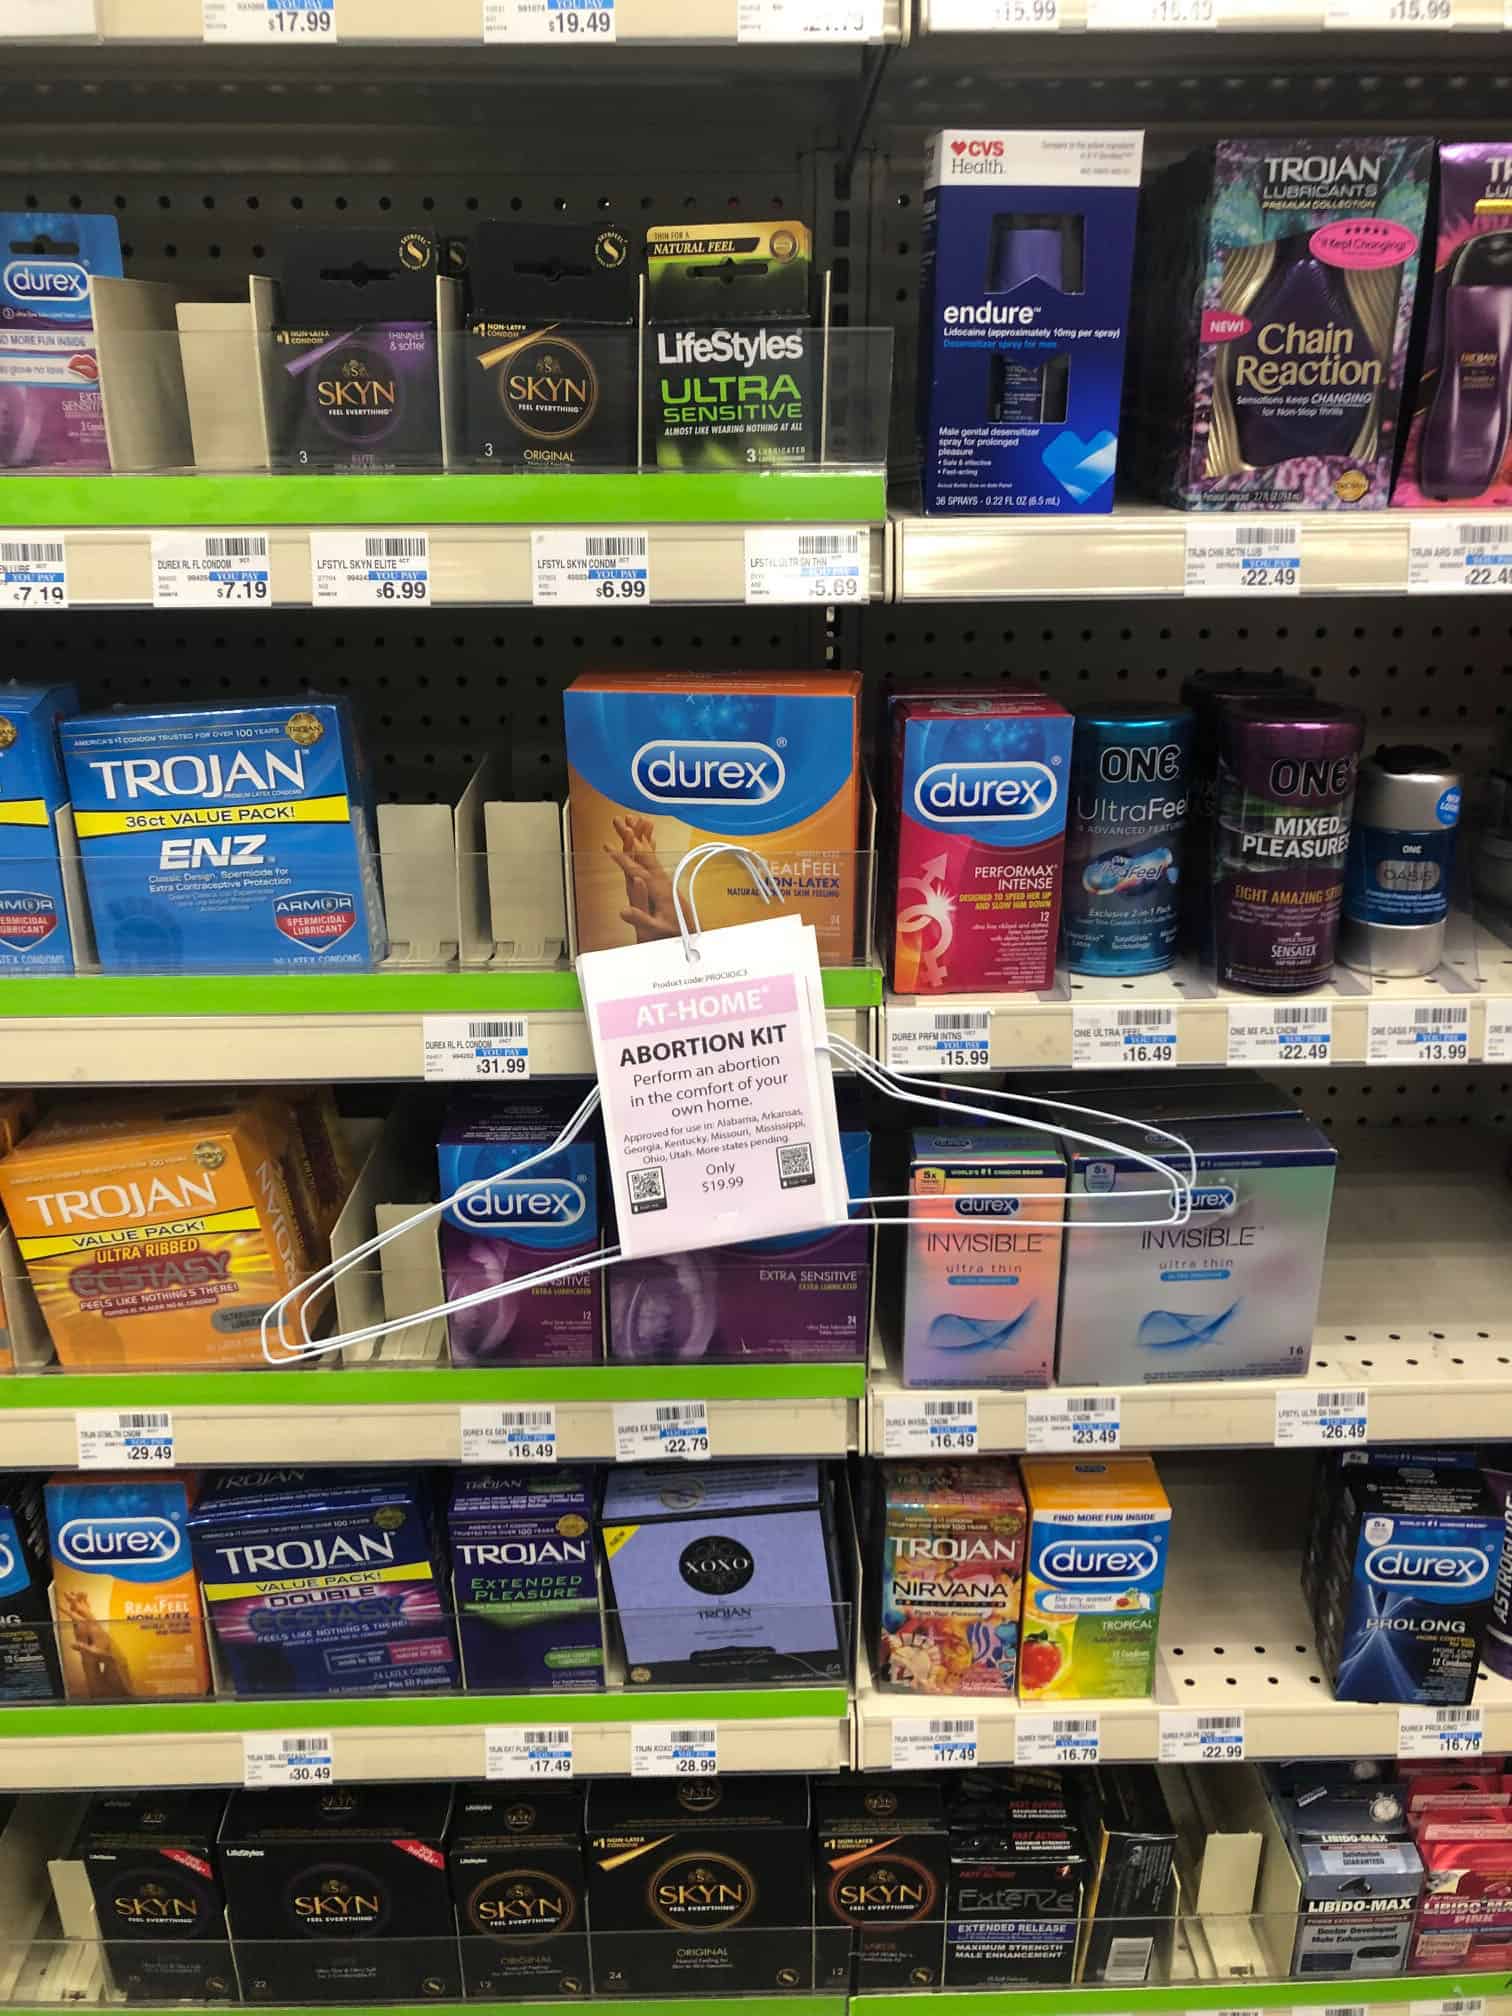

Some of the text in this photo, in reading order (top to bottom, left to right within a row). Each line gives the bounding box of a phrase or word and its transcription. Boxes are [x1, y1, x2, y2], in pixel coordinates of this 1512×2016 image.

[268, 11, 331, 32] $17.99
[549, 12, 611, 33] $19.49
[968, 140, 1005, 157] CVS
[1264, 156, 1381, 184] TROJAN
[1263, 183, 1378, 199] LUBRICANTS
[653, 241, 735, 255] NATURAL FEEL
[13, 267, 82, 292] durex
[1210, 319, 1244, 333] NEW!
[1257, 322, 1353, 354] Chain
[657, 328, 803, 368] LifeStyles
[1236, 356, 1382, 394] Reaction
[318, 381, 396, 406] SKYN
[510, 376, 586, 402] SKYN
[661, 374, 801, 404] ULTRA
[663, 403, 803, 423] SENSITIVE
[664, 427, 693, 436] ALMOST
[694, 426, 710, 435] LIKE
[711, 425, 744, 434] WEARING
[745, 424, 779, 433] NOTHING
[791, 423, 803, 431] ALL
[523, 449, 575, 462] ORIGINAL
[938, 448, 973, 457] pleasure
[317, 559, 397, 569] LFSTYL SKYN ELITE
[537, 558, 616, 569] LFSTYL SKYN CONDM
[1241, 569, 1295, 587] $22.49
[217, 581, 267, 599] $7.19
[376, 581, 426, 599] $6.99
[596, 580, 646, 598] $6.99
[809, 579, 857, 597] $5.69
[649, 750, 768, 789] durex
[1100, 745, 1182, 783] ONE
[89, 749, 305, 799] TROJAN
[1270, 757, 1349, 797] ONE
[930, 773, 1041, 807] durex
[126, 806, 295, 828] 36ct VALUE PACK!
[1274, 816, 1340, 836] MIXED
[159, 834, 267, 869] ENZ
[1242, 835, 1349, 858] PLEASURES
[974, 865, 1054, 878] PERFORMAX
[998, 878, 1053, 890] INTENSE
[1236, 886, 1324, 904] EIGHT AMAZING
[275, 897, 353, 913] ARMOR
[287, 916, 347, 927] SPERMICIDAL
[293, 924, 343, 936] LUBRICANT
[1271, 944, 1317, 958] SENSATEX
[635, 988, 762, 1028] AT-HOME
[620, 1024, 787, 1067] ABORTION KIT
[1123, 1046, 1172, 1062] $16.49
[1279, 1045, 1327, 1060] $22.49
[1419, 1044, 1466, 1059] $13.99
[477, 1058, 525, 1073] $31.99
[941, 1051, 988, 1065] $15.99
[633, 1054, 780, 1087] Perform an abortion
[630, 1073, 788, 1107] in the comfort of your
[672, 1095, 753, 1118] own home.
[623, 1128, 670, 1144] Approved
[671, 1126, 684, 1135] for
[686, 1125, 701, 1134] use
[717, 1116, 759, 1128] Alabama,
[624, 1144, 663, 1157] Georgia,
[711, 1130, 751, 1142] Missouri,
[755, 1119, 806, 1134] Mississippi,
[642, 1155, 668, 1165] Ohio,
[696, 1146, 719, 1156] More
[721, 1142, 748, 1153] states
[750, 1135, 789, 1150] pending
[706, 1162, 735, 1176] Only
[702, 1176, 744, 1193] $19.99
[26, 1172, 217, 1227] TROJAN
[467, 1190, 570, 1215] durex
[959, 1198, 1017, 1213] durex
[72, 1220, 205, 1248] VALUE PACK!
[927, 1233, 1043, 1252] INVISIBLE
[1141, 1226, 1256, 1250] INVISIBLE
[97, 1238, 198, 1263] ULTRA RIBBED
[760, 1271, 856, 1281] EXTRA SENSITIVE
[946, 1264, 1022, 1273] ultra thin
[80, 1283, 238, 1311] FEELS LIKE NOTHING'S THERE!
[930, 1434, 975, 1448] $16.49
[1072, 1430, 1117, 1445] $23.49
[1321, 1425, 1366, 1439] $26.49
[127, 1446, 172, 1460] $29.49
[509, 1444, 553, 1457] $16.49
[664, 1438, 708, 1452] $22.79
[71, 1526, 168, 1553] durex
[216, 1532, 395, 1575] TROJAN
[456, 1541, 587, 1566] TROJAN
[889, 1537, 1017, 1561] TROJAN
[686, 1558, 749, 1574] XOXO
[1052, 1548, 1145, 1572] durex
[1378, 1553, 1475, 1577] durex
[256, 1571, 381, 1592] VALUE PACK!
[471, 1575, 582, 1589] EXTENDED
[892, 1581, 1009, 1598] NIRVANA
[269, 1587, 377, 1607] DOUBLE
[475, 1588, 577, 1601] PLEASURE
[1103, 1620, 1152, 1631] TROPICAL
[1366, 1618, 1465, 1633] PROLONG
[1202, 1746, 1242, 1758] $22.99
[1440, 1738, 1480, 1751] $16.79
[935, 1749, 975, 1761] $17.49
[1057, 1748, 1097, 1760] $16.79
[289, 1767, 331, 1780] $30.49
[530, 1760, 571, 1773] $17.49
[676, 1759, 716, 1772] $28.99
[659, 1885, 742, 1905] SKYN
[841, 1884, 922, 1904] SKYN
[115, 1897, 197, 1916] SKYN
[295, 1896, 379, 1915] SKYN
[480, 1898, 561, 1921] SKYN
[1308, 1898, 1412, 1914] LIBIDO-MAX
[958, 1923, 1067, 1933] EXTENDED RELEASE
[1009, 1943, 1063, 1951] STRENGTH
